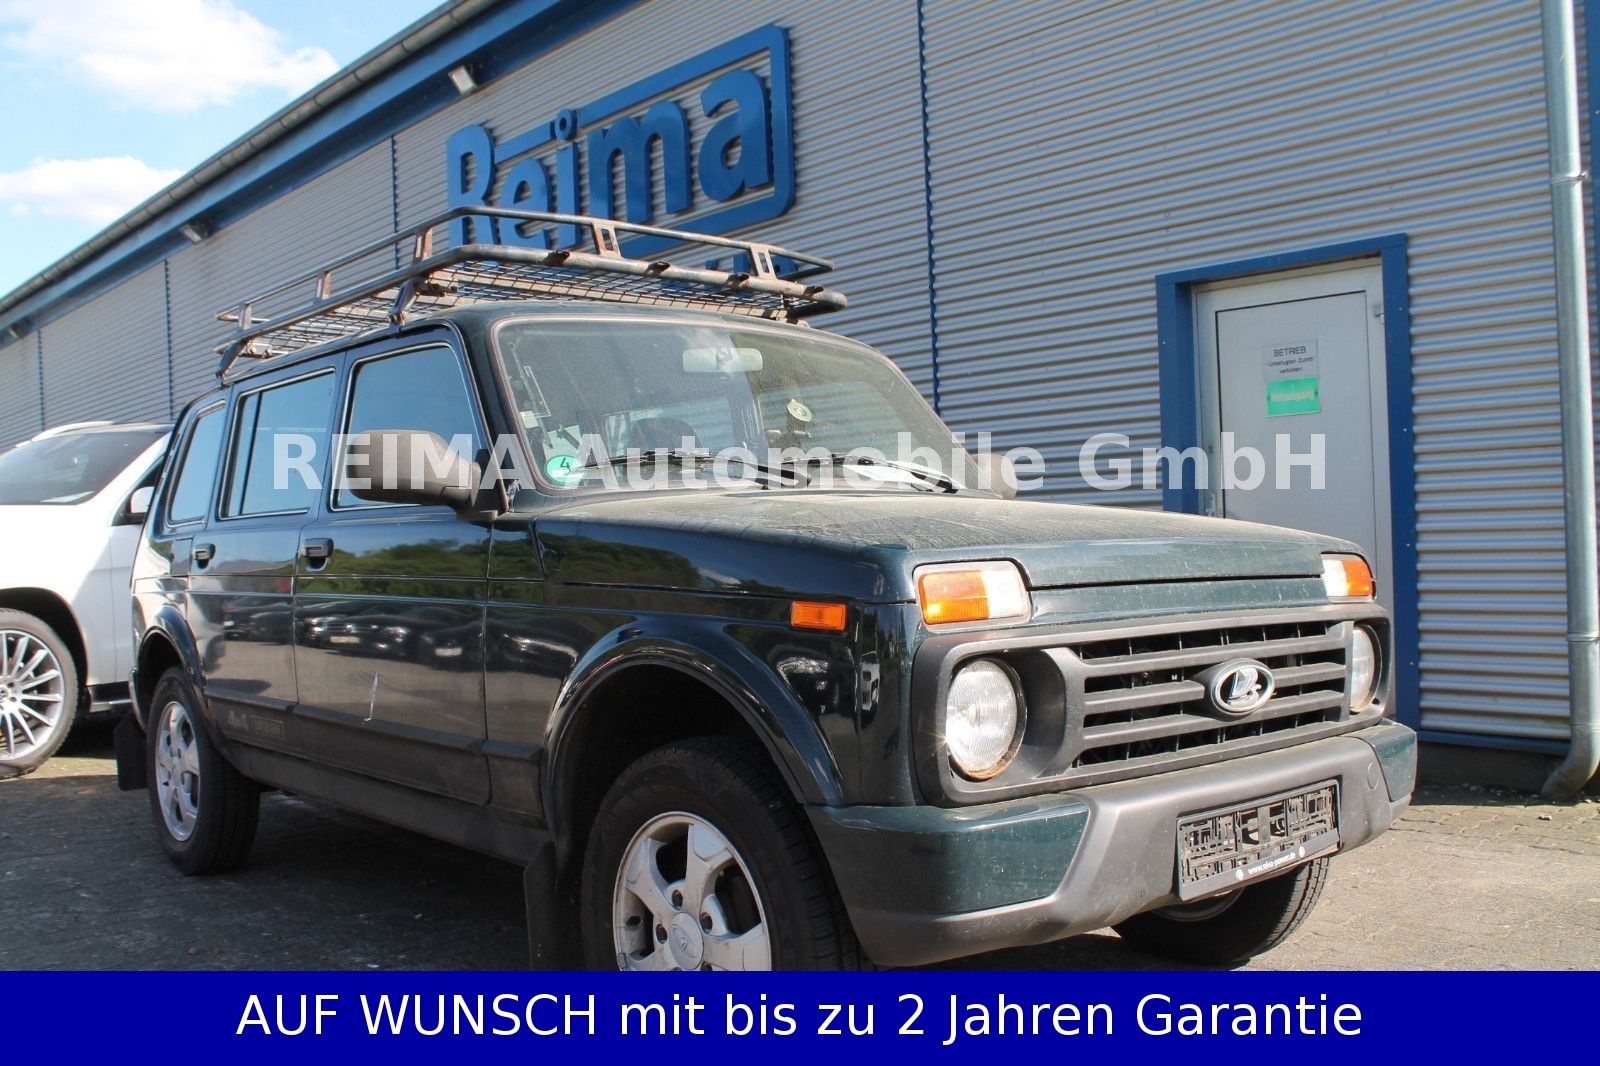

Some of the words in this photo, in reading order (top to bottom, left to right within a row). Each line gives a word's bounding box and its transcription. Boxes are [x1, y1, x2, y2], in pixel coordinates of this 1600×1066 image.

[446, 69, 773, 250] Reima
[1273, 346, 1306, 357] BETRIEB
[559, 456, 571, 472] 4
